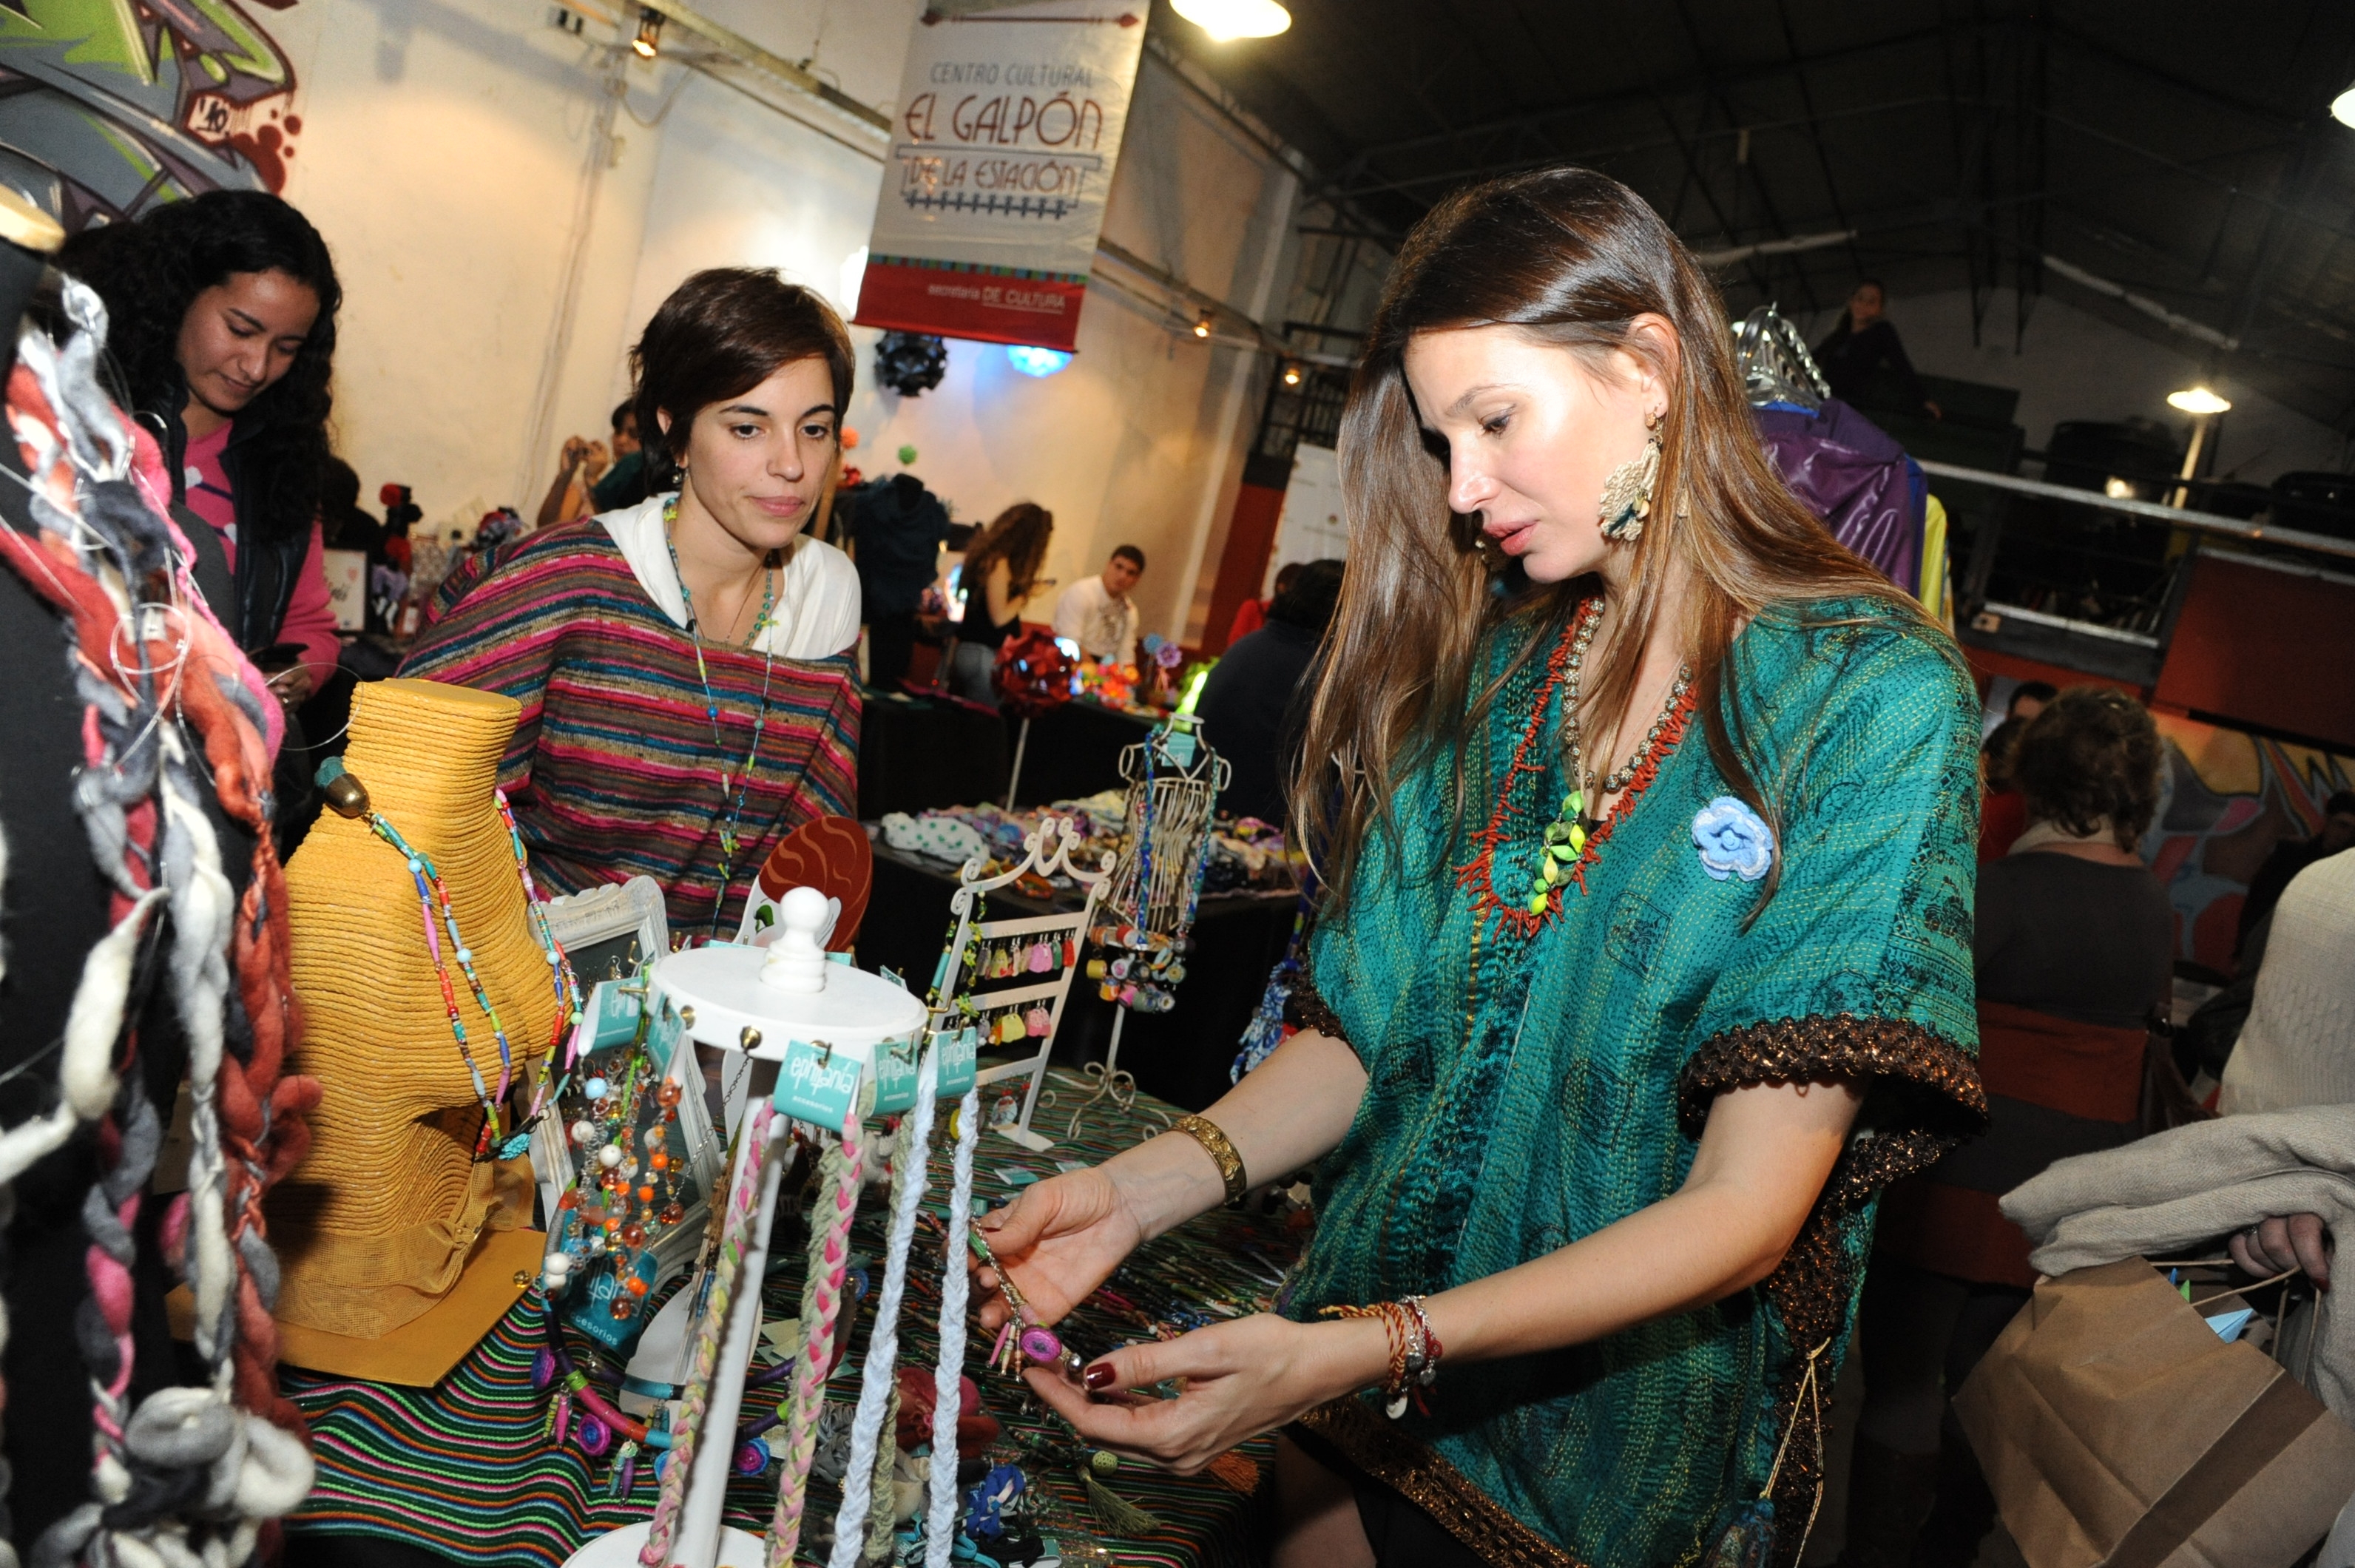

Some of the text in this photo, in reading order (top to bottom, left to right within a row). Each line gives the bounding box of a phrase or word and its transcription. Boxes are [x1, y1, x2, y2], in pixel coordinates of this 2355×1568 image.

[930, 62, 1093, 88] CENTRO CULTURAL
[905, 92, 936, 140] EL
[943, 158, 968, 186] LA
[570, 1312, 618, 1345] ccesorios
